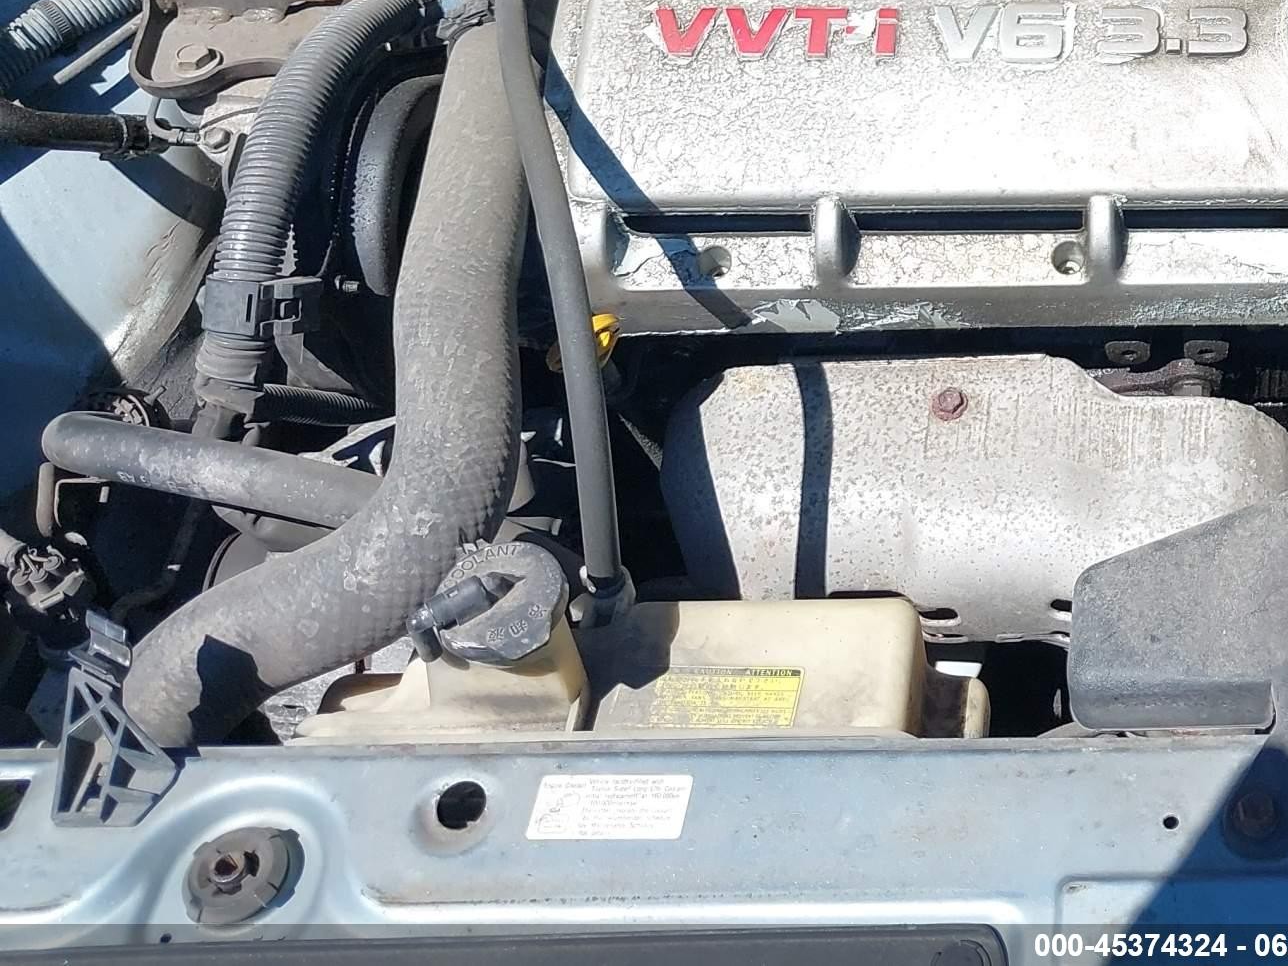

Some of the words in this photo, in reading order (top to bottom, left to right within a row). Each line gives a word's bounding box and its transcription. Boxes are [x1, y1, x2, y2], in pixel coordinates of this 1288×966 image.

[654, 6, 902, 60] VVT-i
[934, 4, 1066, 63] V6
[1099, 6, 1250, 58] 3.3
[444, 544, 522, 588] COOLANT
[746, 668, 793, 676] ATTENTION
